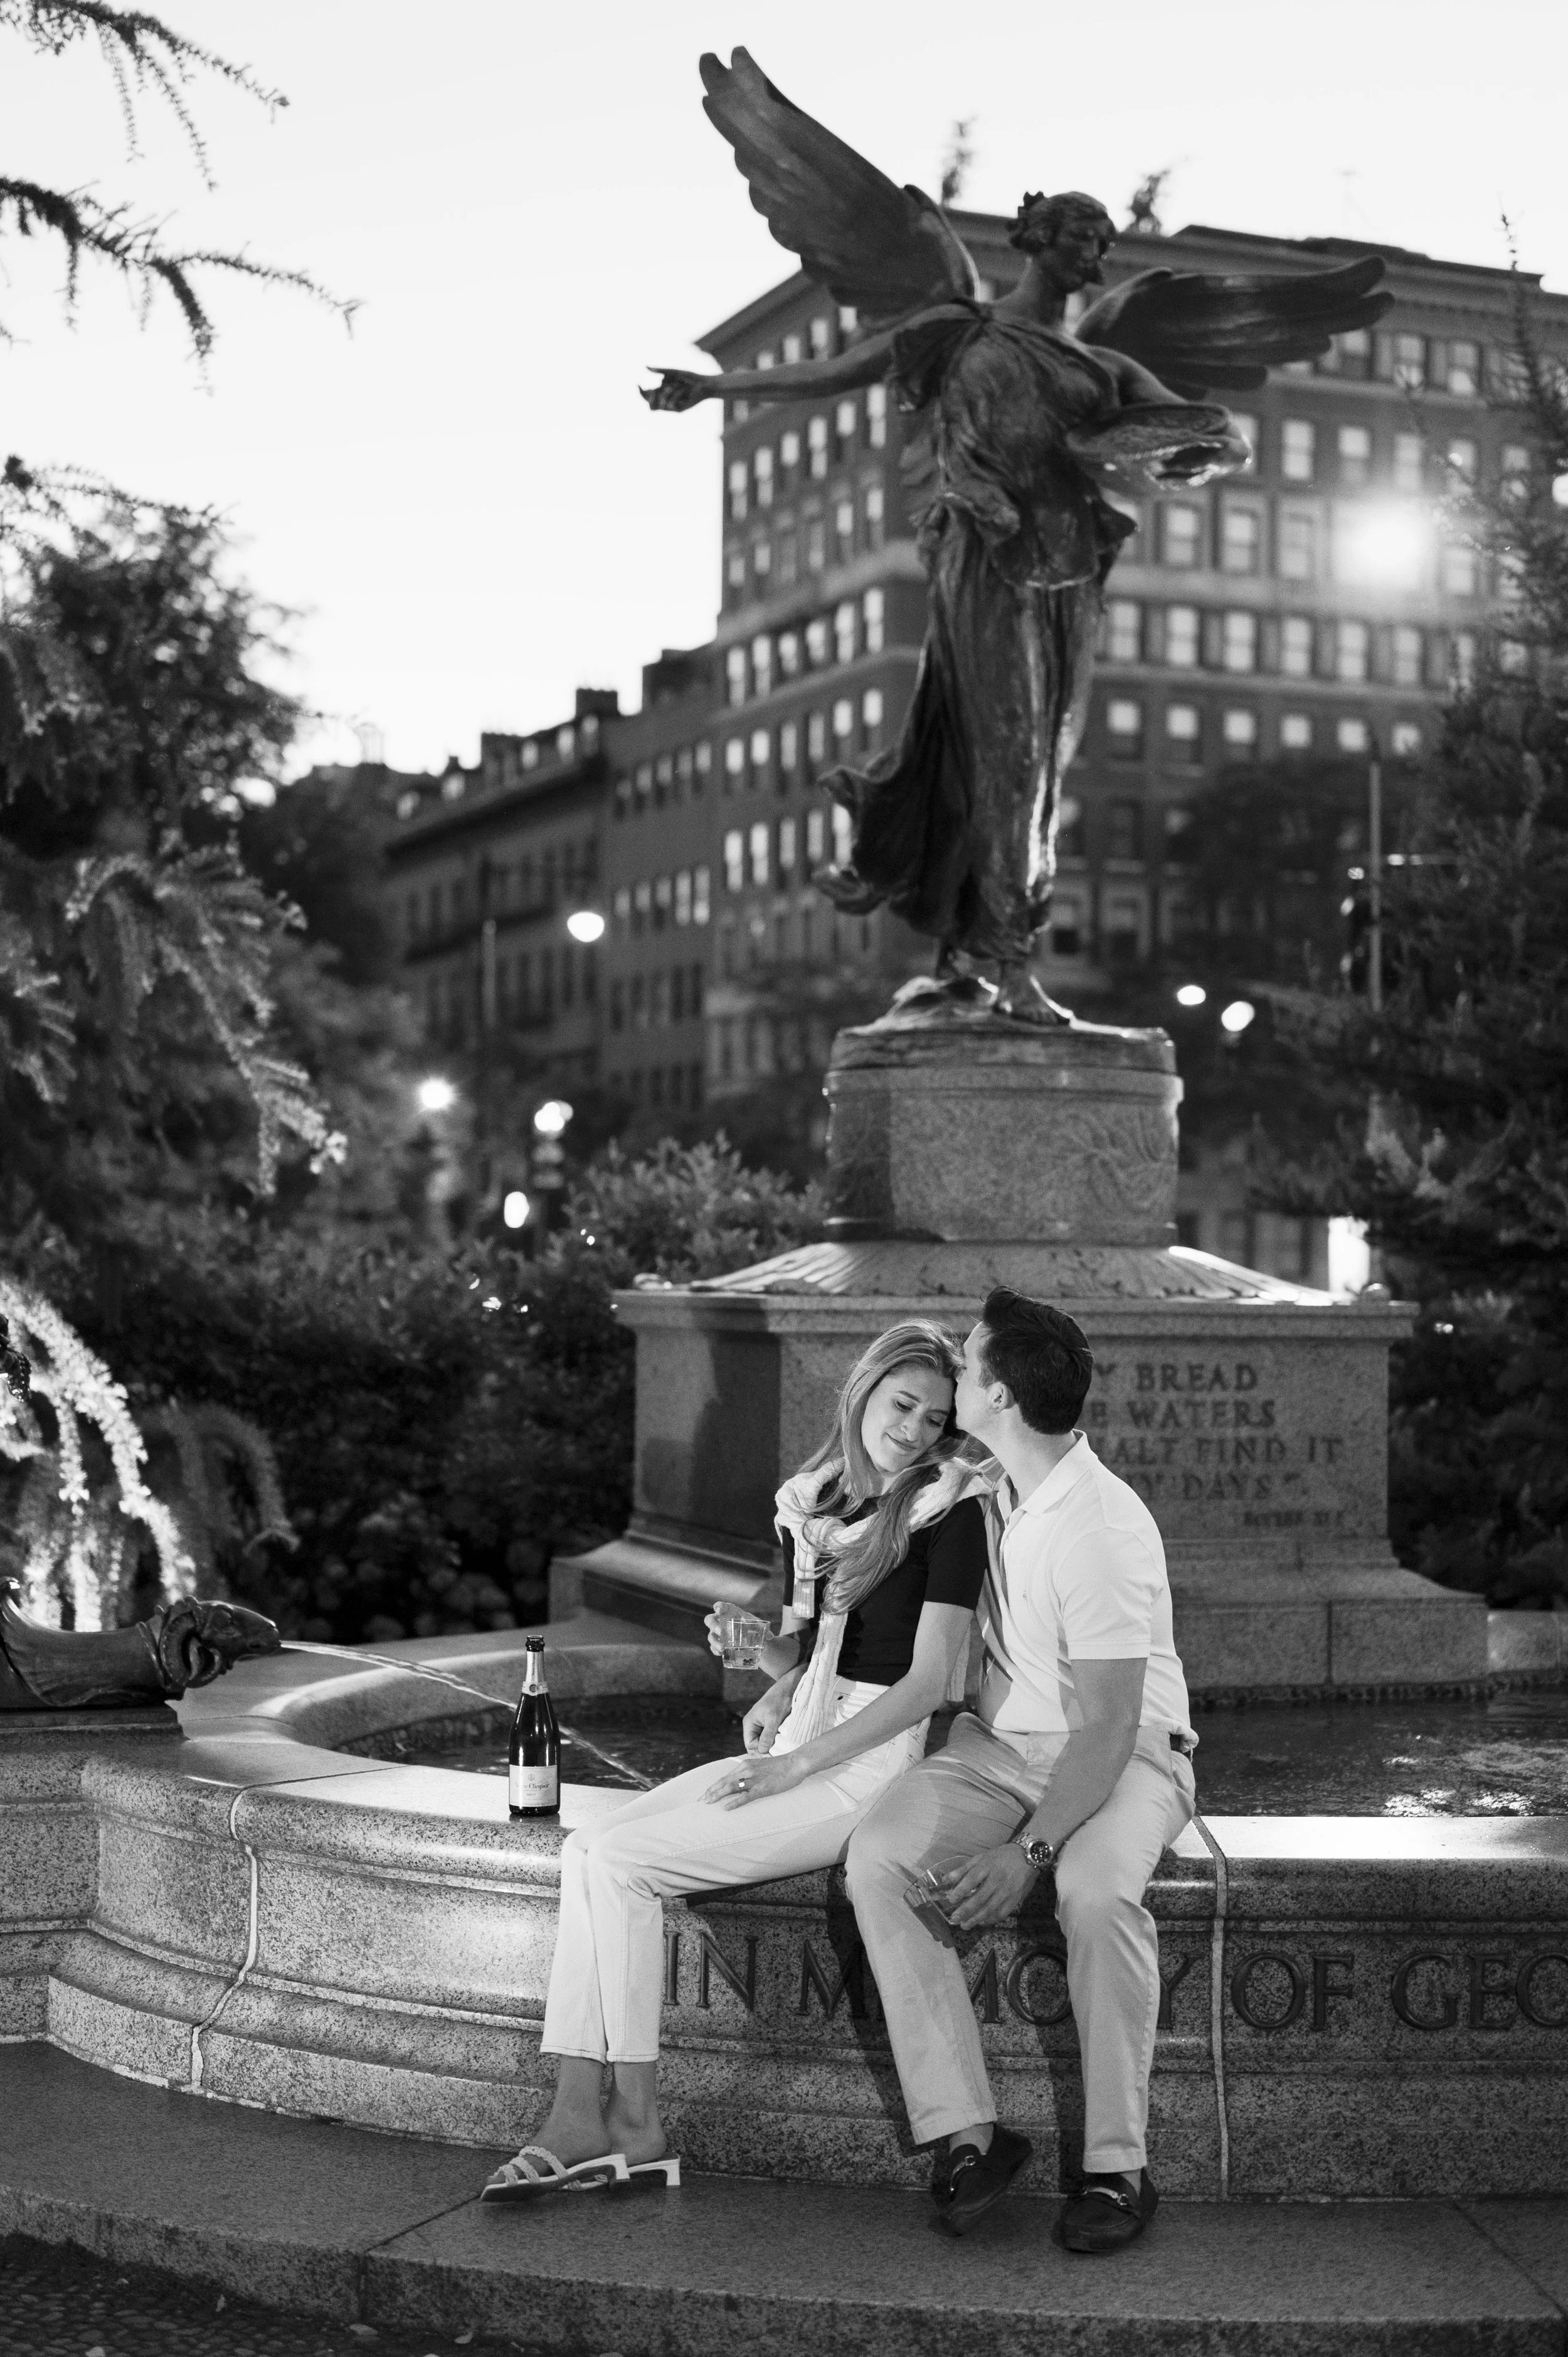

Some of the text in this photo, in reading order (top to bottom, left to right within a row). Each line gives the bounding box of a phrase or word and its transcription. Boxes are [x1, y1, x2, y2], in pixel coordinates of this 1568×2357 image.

[1136, 1363, 1258, 1392] BREAD
[1127, 1399, 1276, 1429] WATERS
[1094, 1435, 1344, 1466] ALT FIND IT
[662, 1930, 760, 2014] IN
[1231, 1950, 1354, 2032] OF
